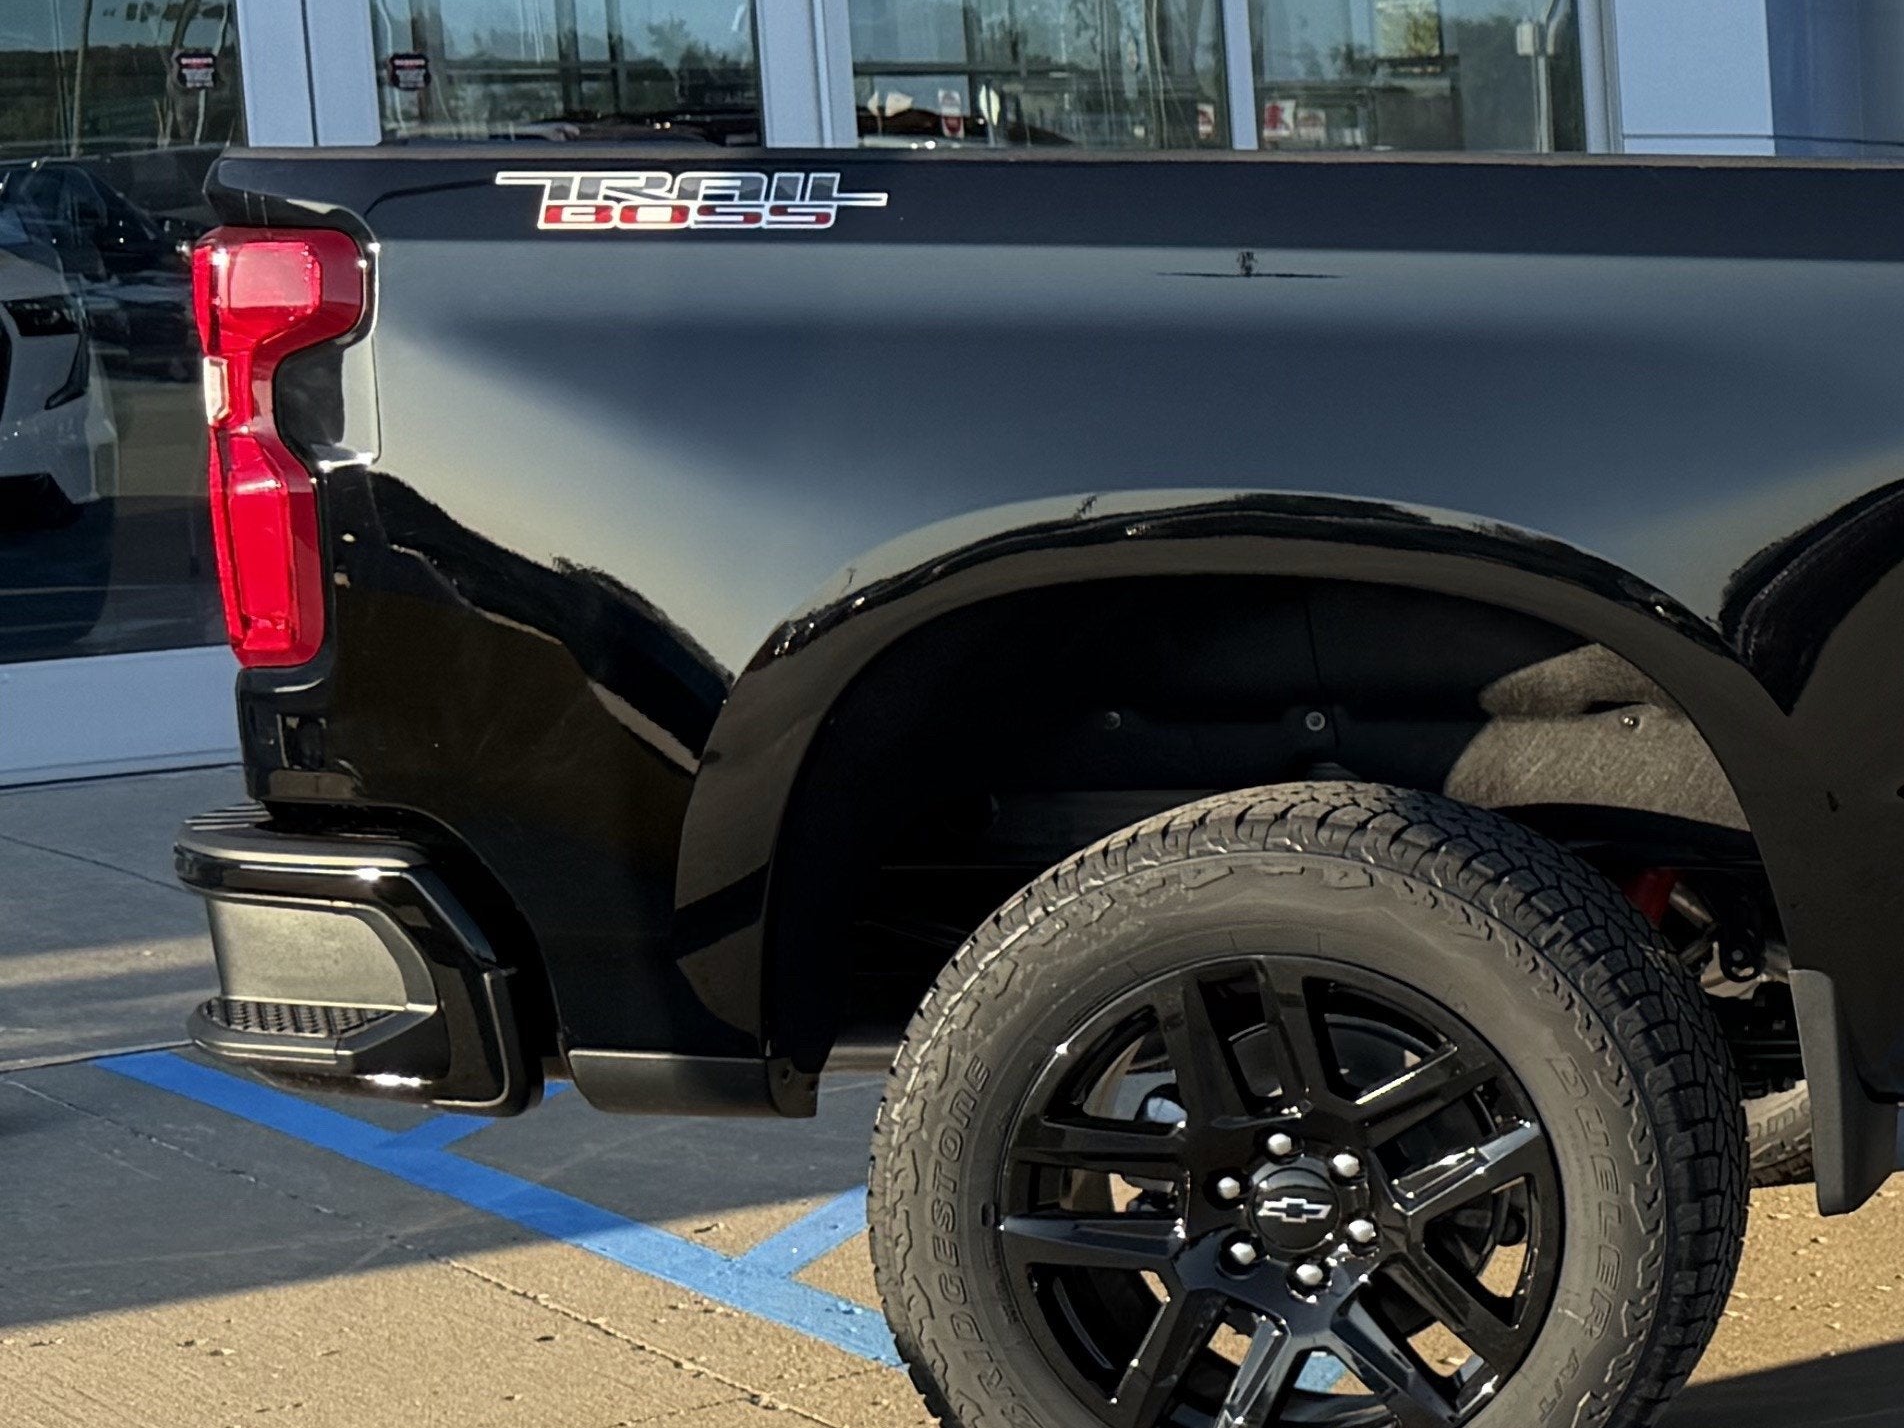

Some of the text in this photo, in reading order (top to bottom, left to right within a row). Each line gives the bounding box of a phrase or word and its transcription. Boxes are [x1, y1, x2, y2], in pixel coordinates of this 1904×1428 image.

[495, 171, 889, 207] TRAIL
[537, 201, 838, 230] BOSS
[1547, 1054, 1623, 1341] DUELER
